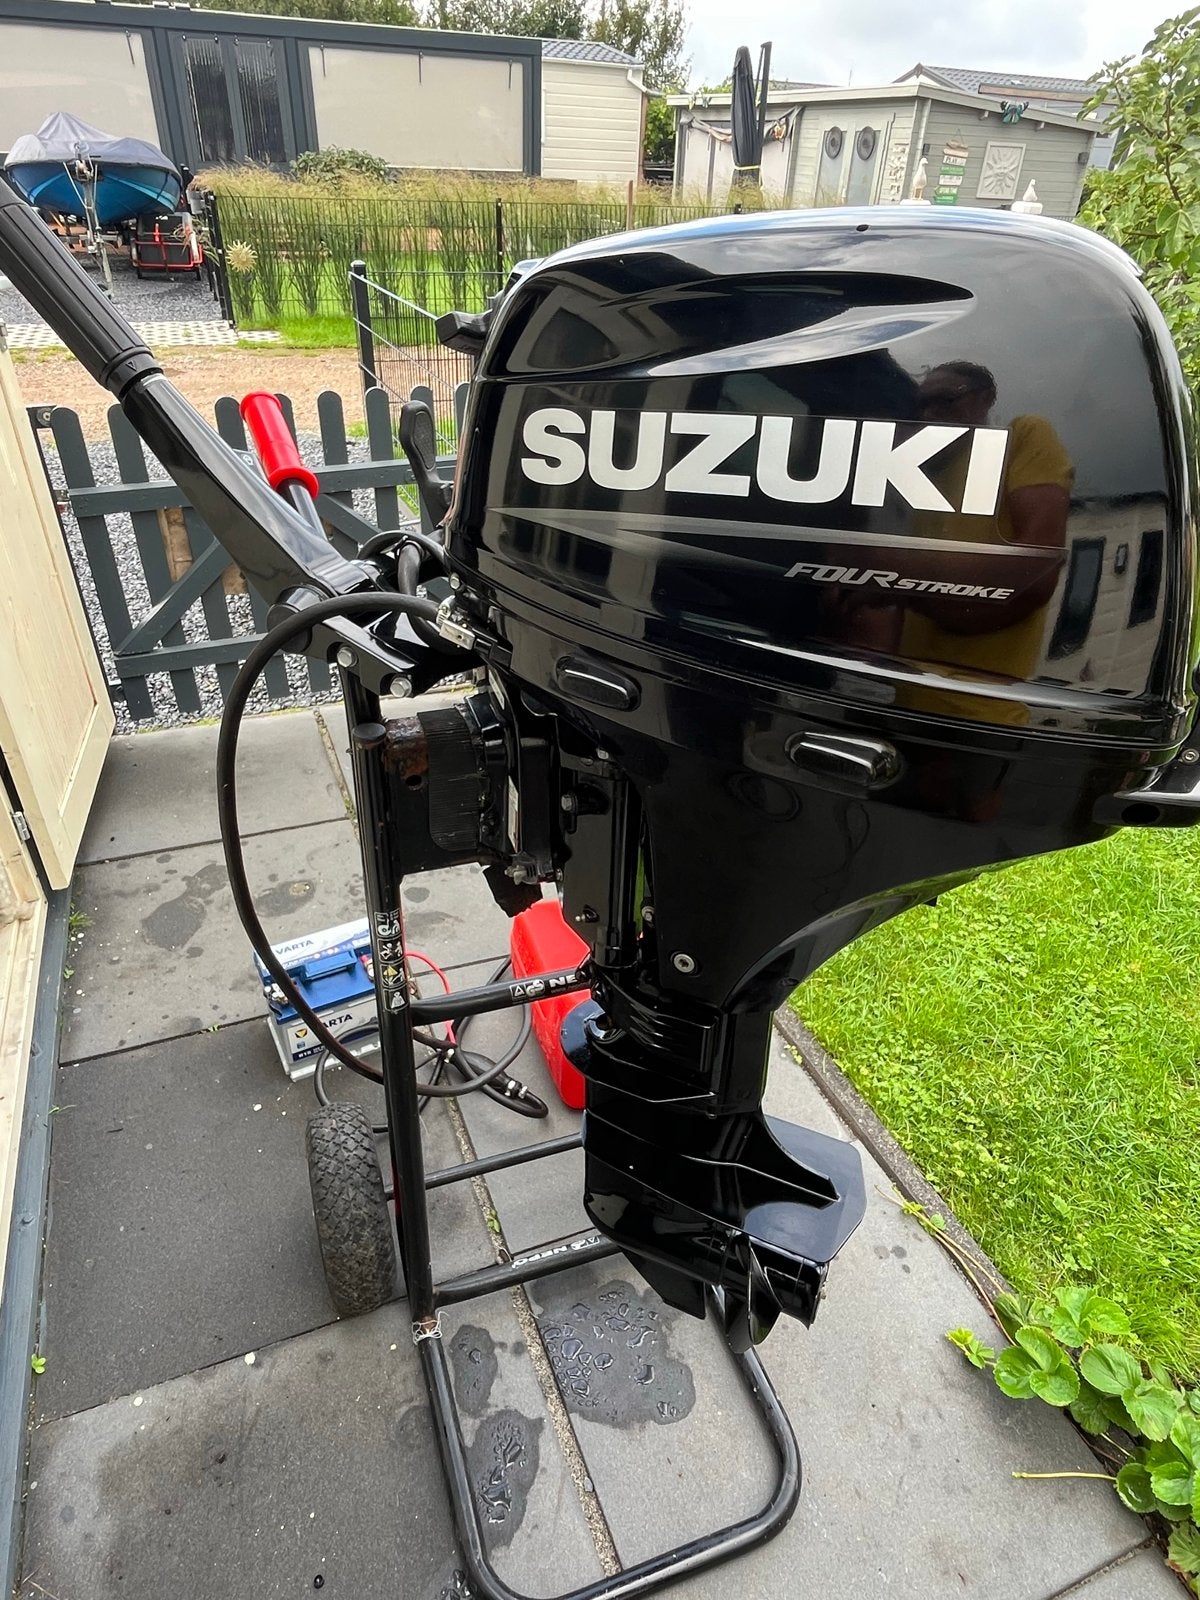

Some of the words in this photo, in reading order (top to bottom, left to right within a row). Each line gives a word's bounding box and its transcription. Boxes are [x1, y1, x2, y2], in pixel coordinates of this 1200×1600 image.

[521, 408, 1009, 516] SUZUKI
[784, 562, 899, 589] FOUR
[894, 578, 1015, 600] STROKE
[275, 939, 315, 955] VARTA
[322, 1013, 353, 1029] ARTA
